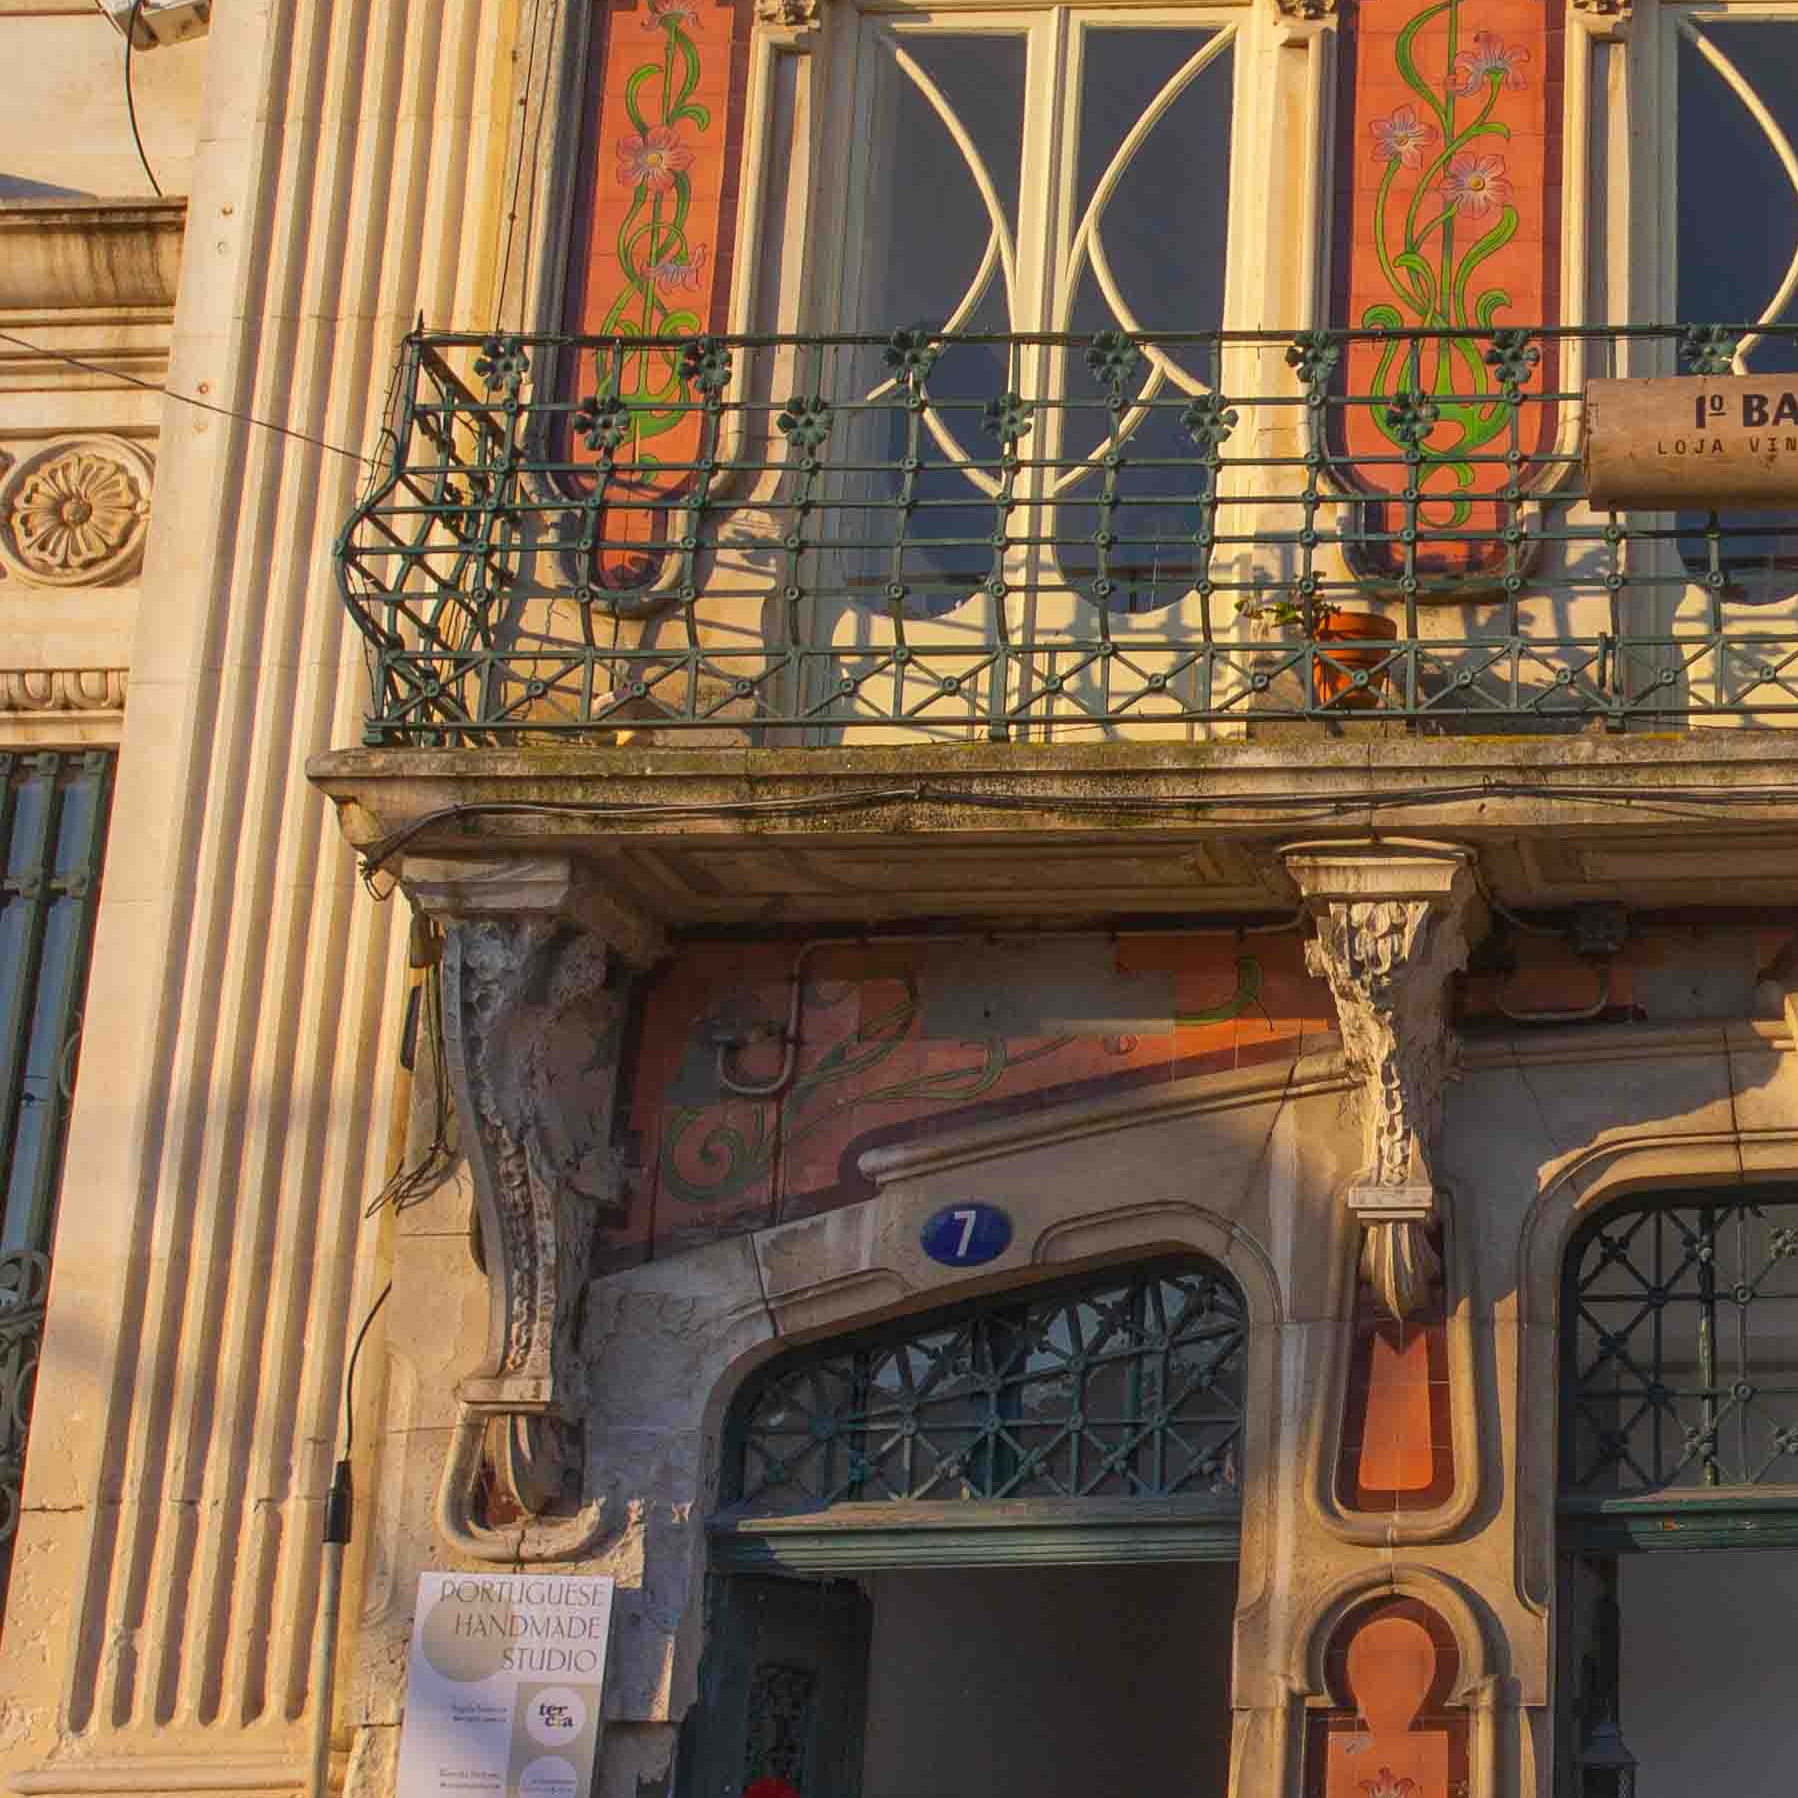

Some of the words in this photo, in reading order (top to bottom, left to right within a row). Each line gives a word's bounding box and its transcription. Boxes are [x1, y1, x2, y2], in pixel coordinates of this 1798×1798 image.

[1657, 439, 1725, 455] LOJA
[953, 1210, 976, 1257] 7
[441, 1580, 605, 1606] PORTUGUESE
[456, 1613, 601, 1640] HANDMADE
[501, 1648, 598, 1673] STUDIO
